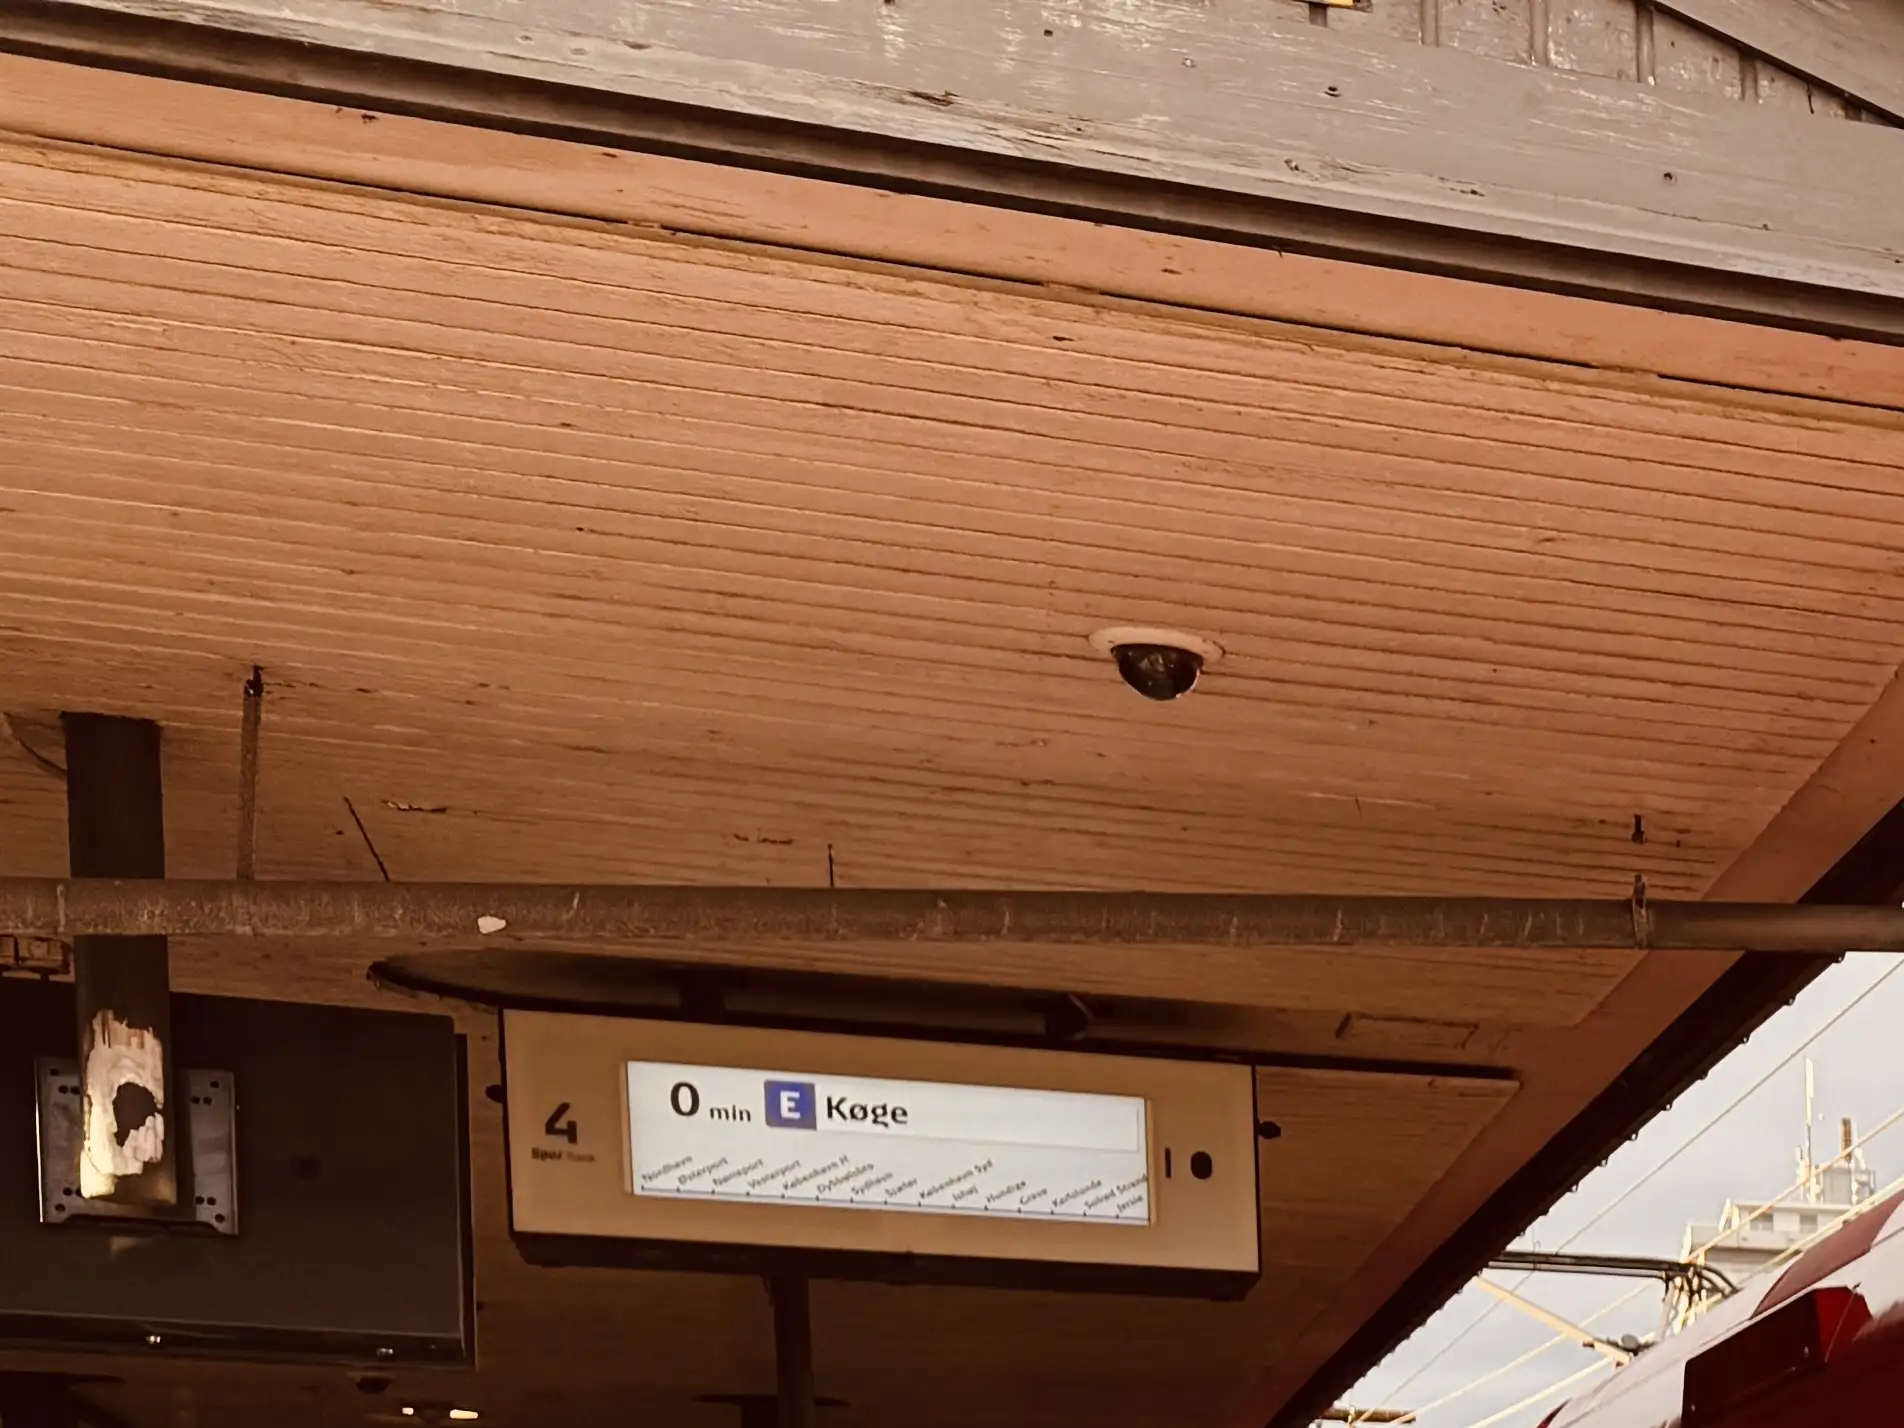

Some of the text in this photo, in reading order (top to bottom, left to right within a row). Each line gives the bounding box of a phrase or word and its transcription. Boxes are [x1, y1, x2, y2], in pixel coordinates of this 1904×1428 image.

[545, 1101, 578, 1144] 4
[670, 1081, 908, 1128] 0 min E Køge
